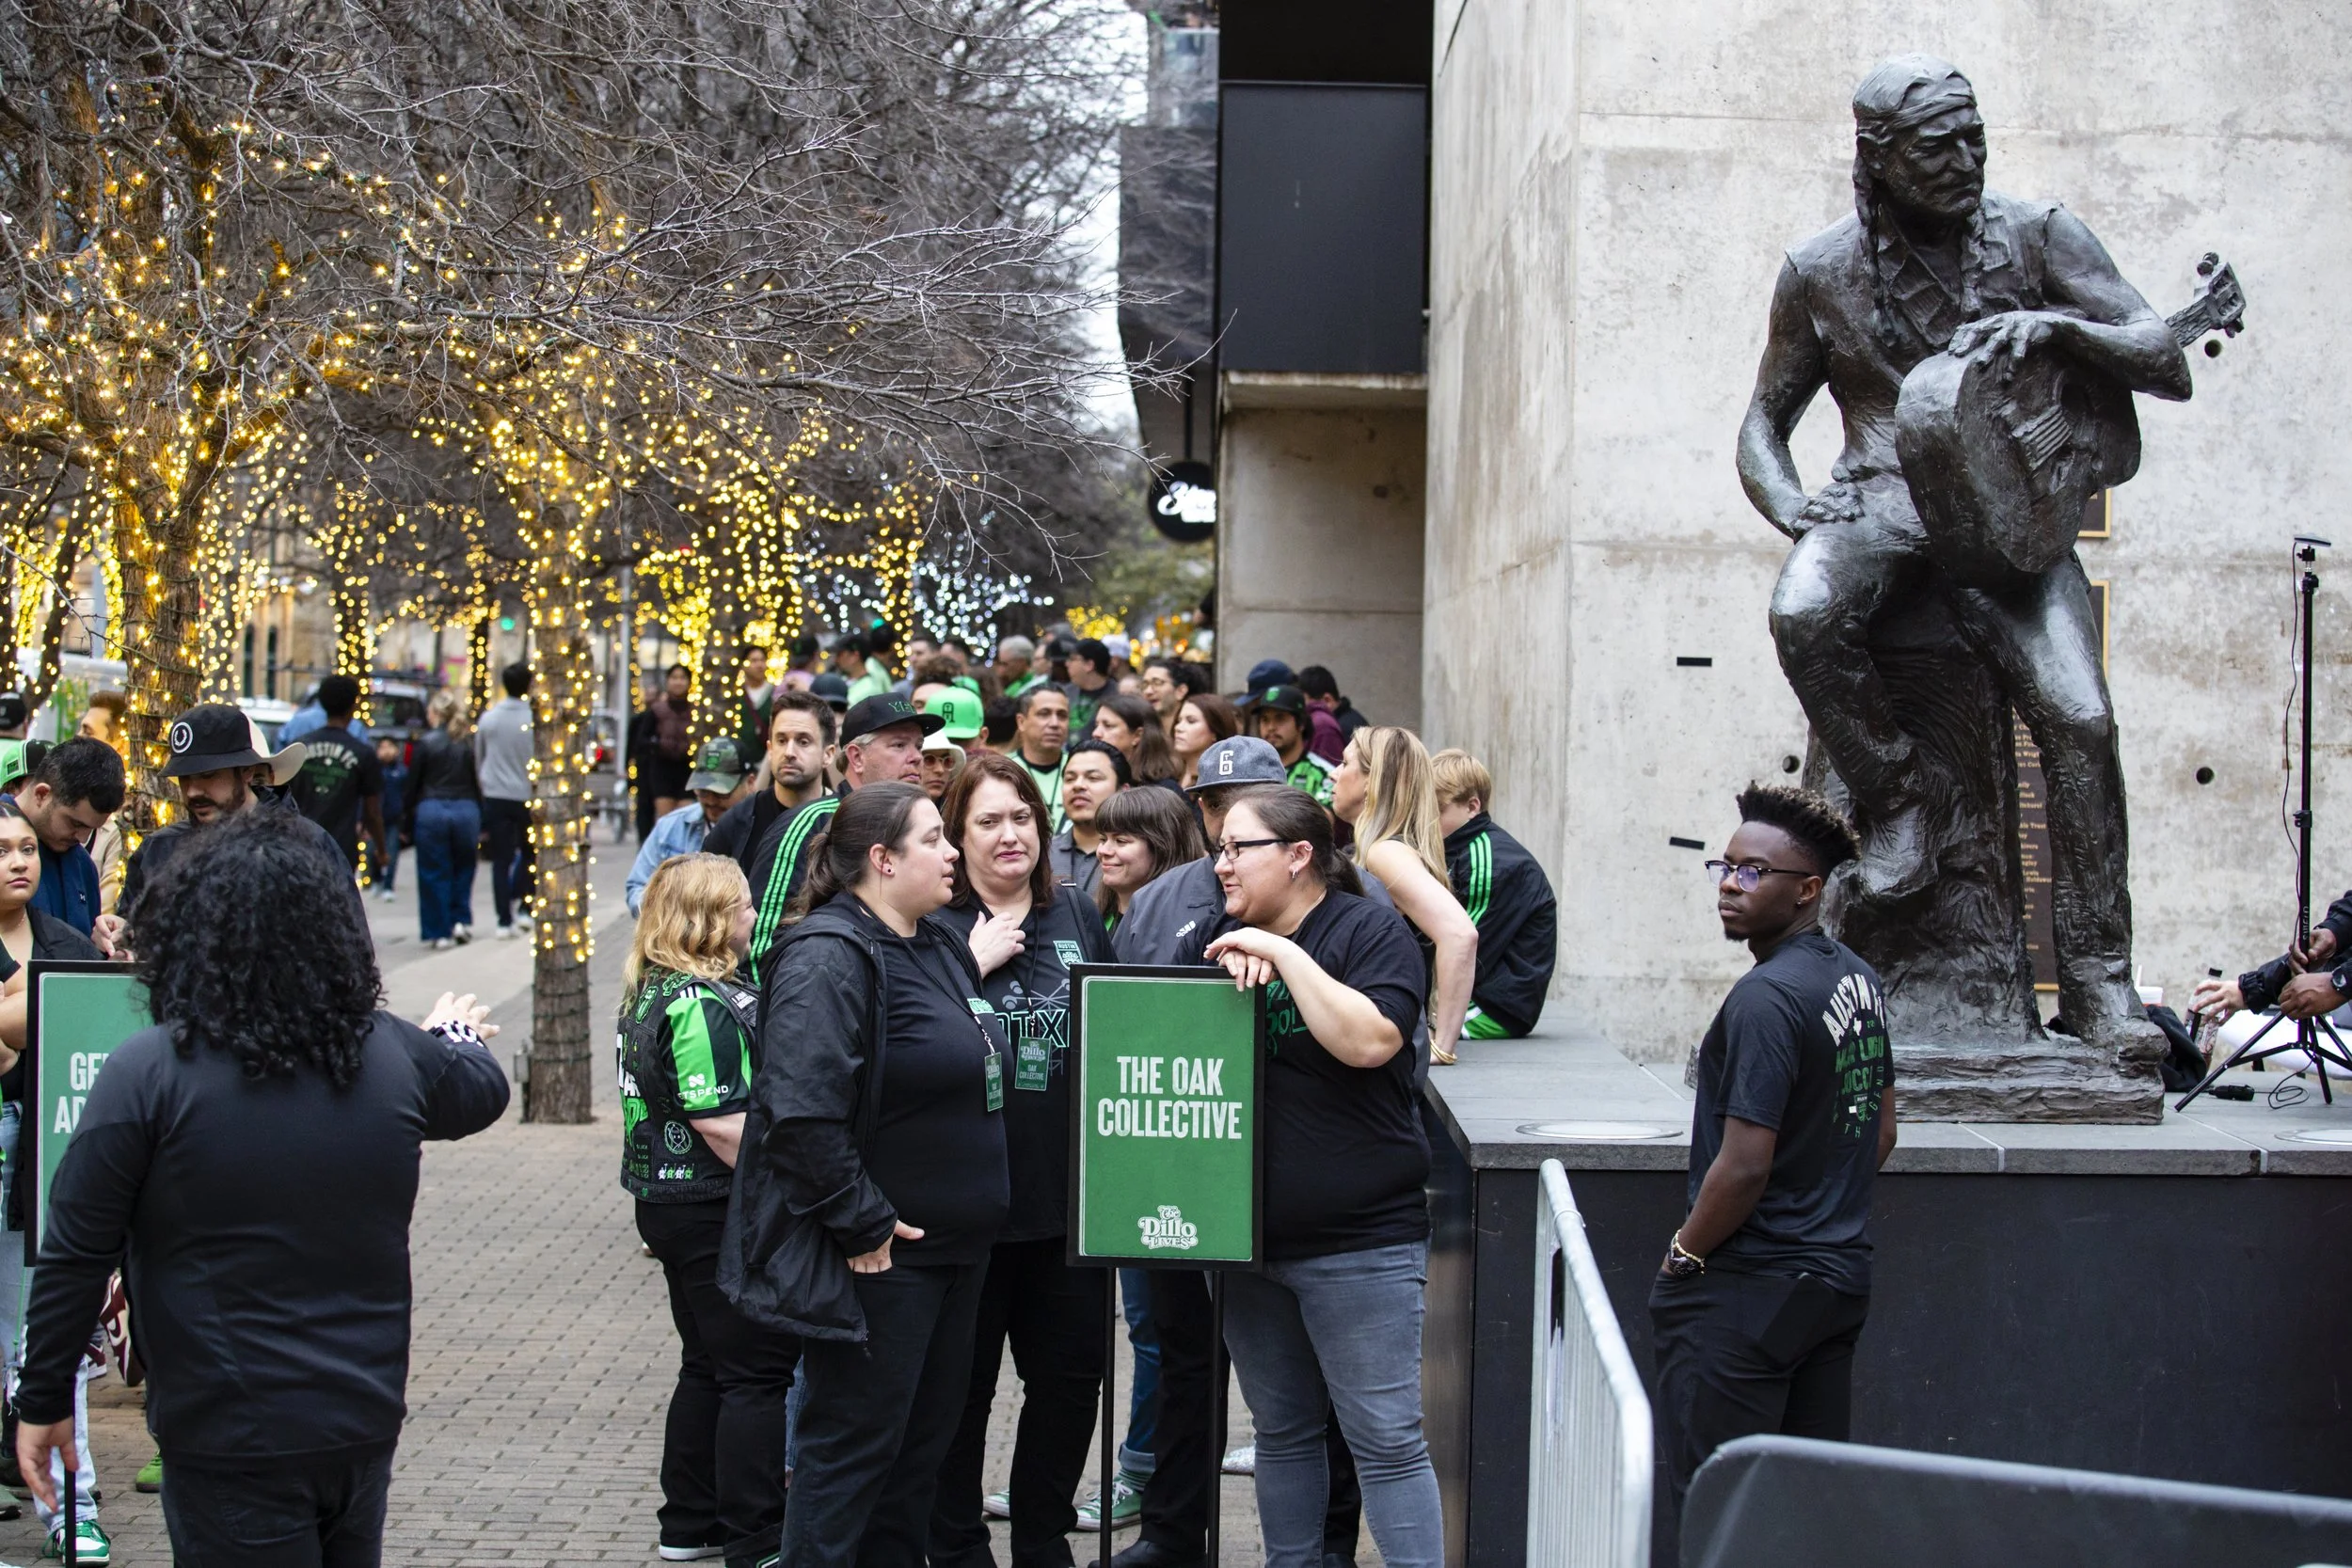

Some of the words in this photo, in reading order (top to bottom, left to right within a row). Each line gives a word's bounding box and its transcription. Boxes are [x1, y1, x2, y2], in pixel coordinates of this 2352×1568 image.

[1821, 973, 1871, 1047] AUSTIN
[1117, 1055, 1164, 1095] THE
[1172, 1056, 1224, 1097] OAK
[1097, 1098, 1243, 1140] COLLECTIVE
[1138, 1217, 1197, 1237] Dillo
